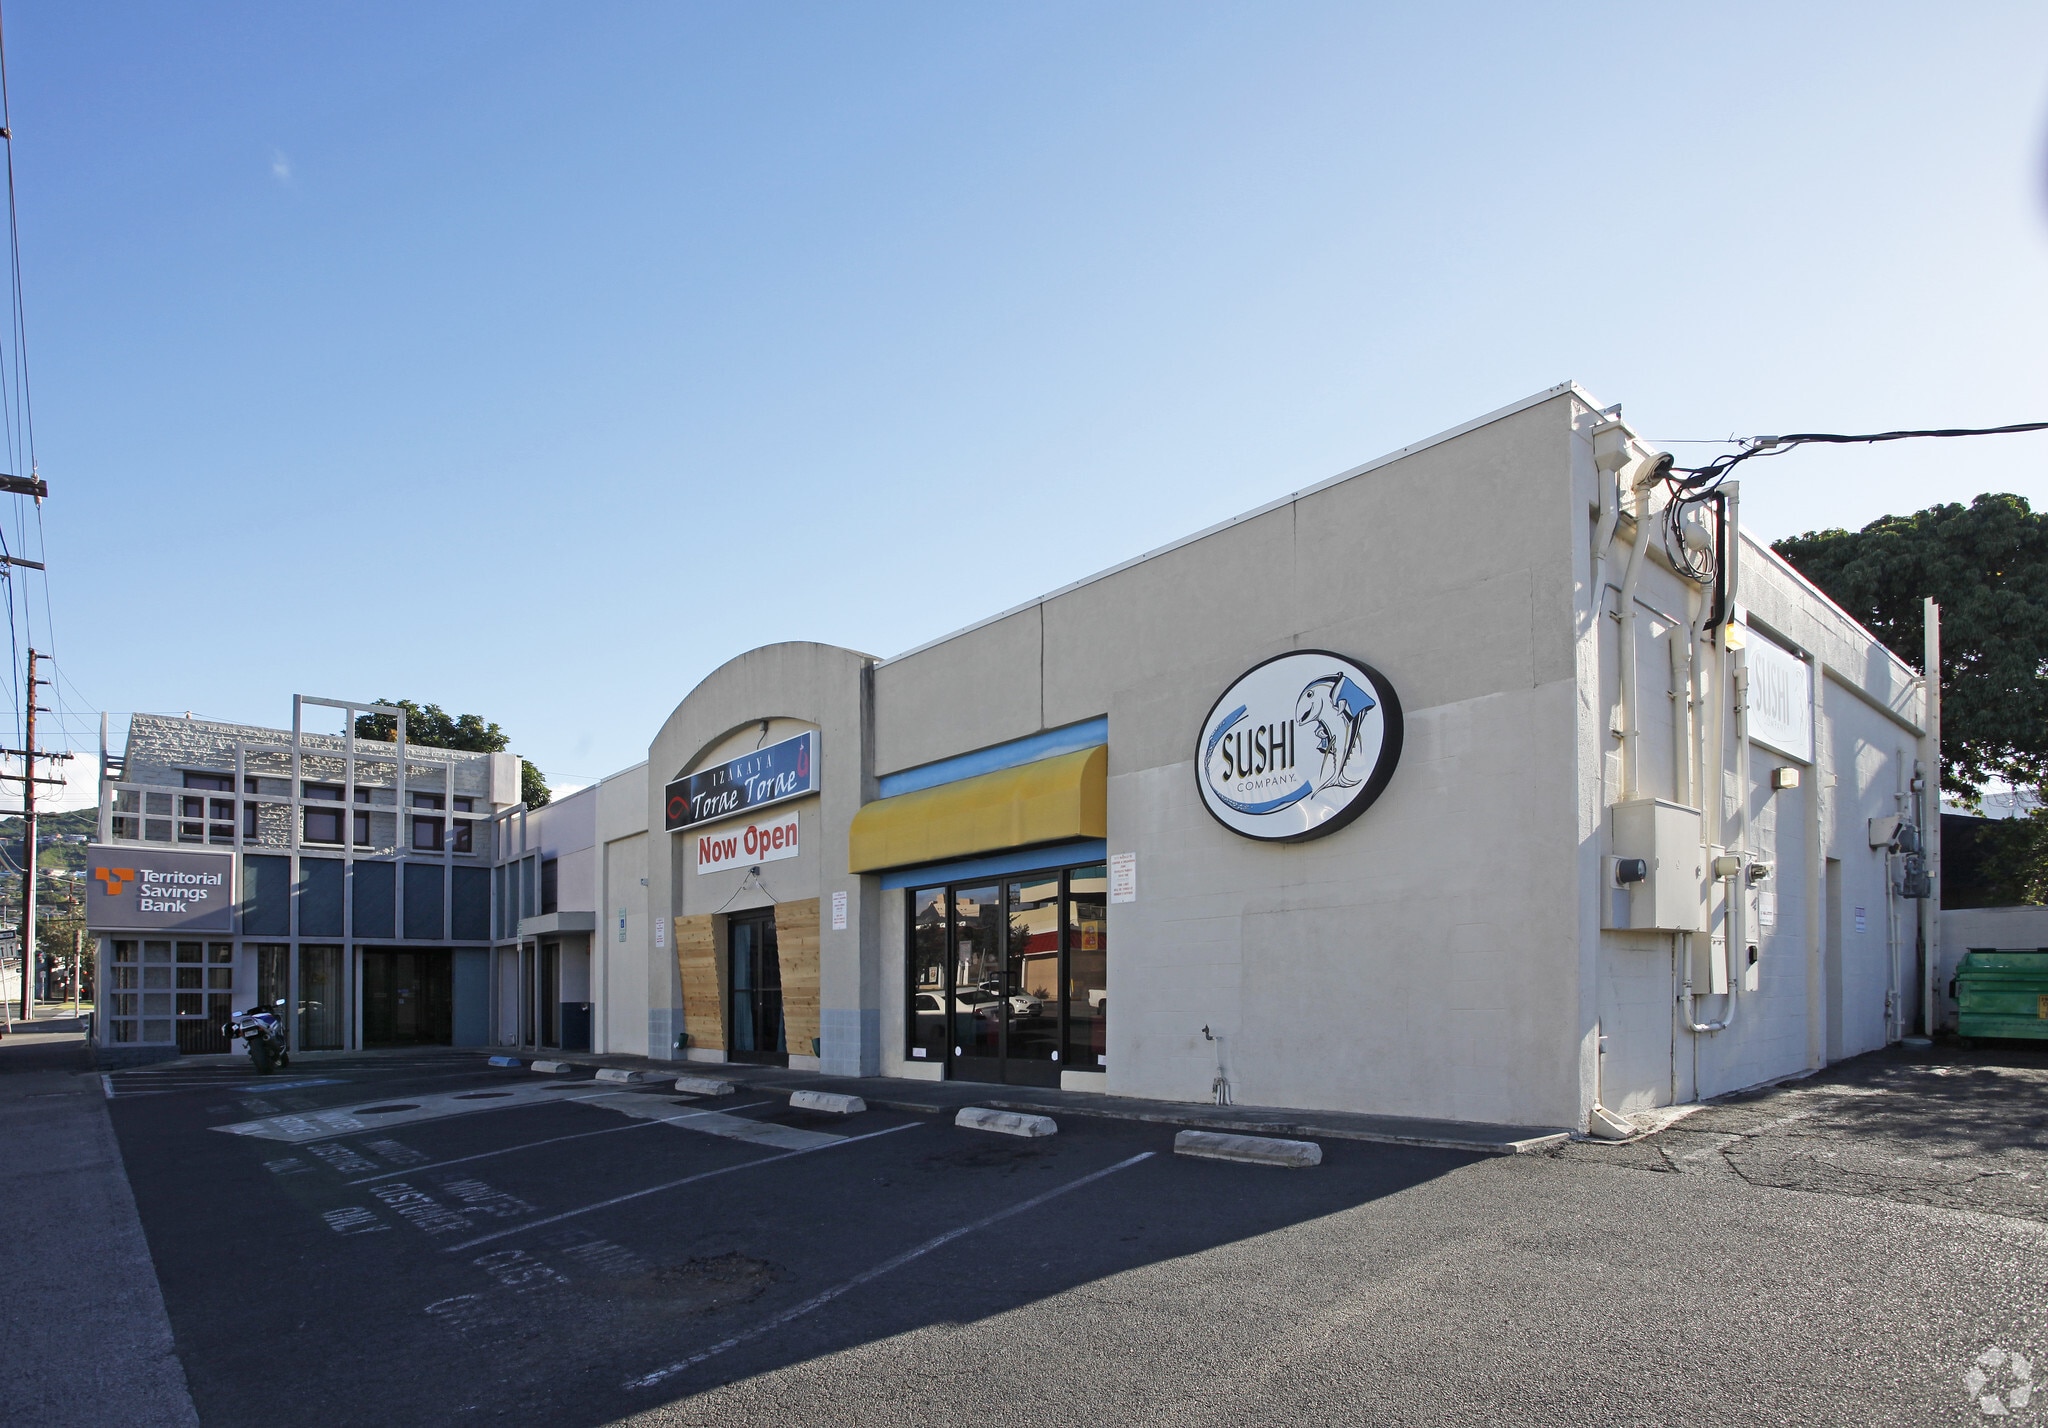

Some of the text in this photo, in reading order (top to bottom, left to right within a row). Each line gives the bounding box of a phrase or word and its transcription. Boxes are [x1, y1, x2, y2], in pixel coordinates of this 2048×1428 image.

[1755, 653, 1790, 726] SUSHI
[1222, 719, 1295, 782] SUSHI
[712, 754, 772, 787] IZAKAYA
[1237, 774, 1296, 792] COMPANY
[692, 770, 797, 819] Torae Torae
[699, 822, 798, 865] Now Open
[140, 869, 222, 886] Territorial
[140, 884, 208, 902] Savings
[140, 899, 187, 913] Bank
[321, 1206, 392, 1236] ONLY
[369, 1183, 474, 1235] CUSTOMER
